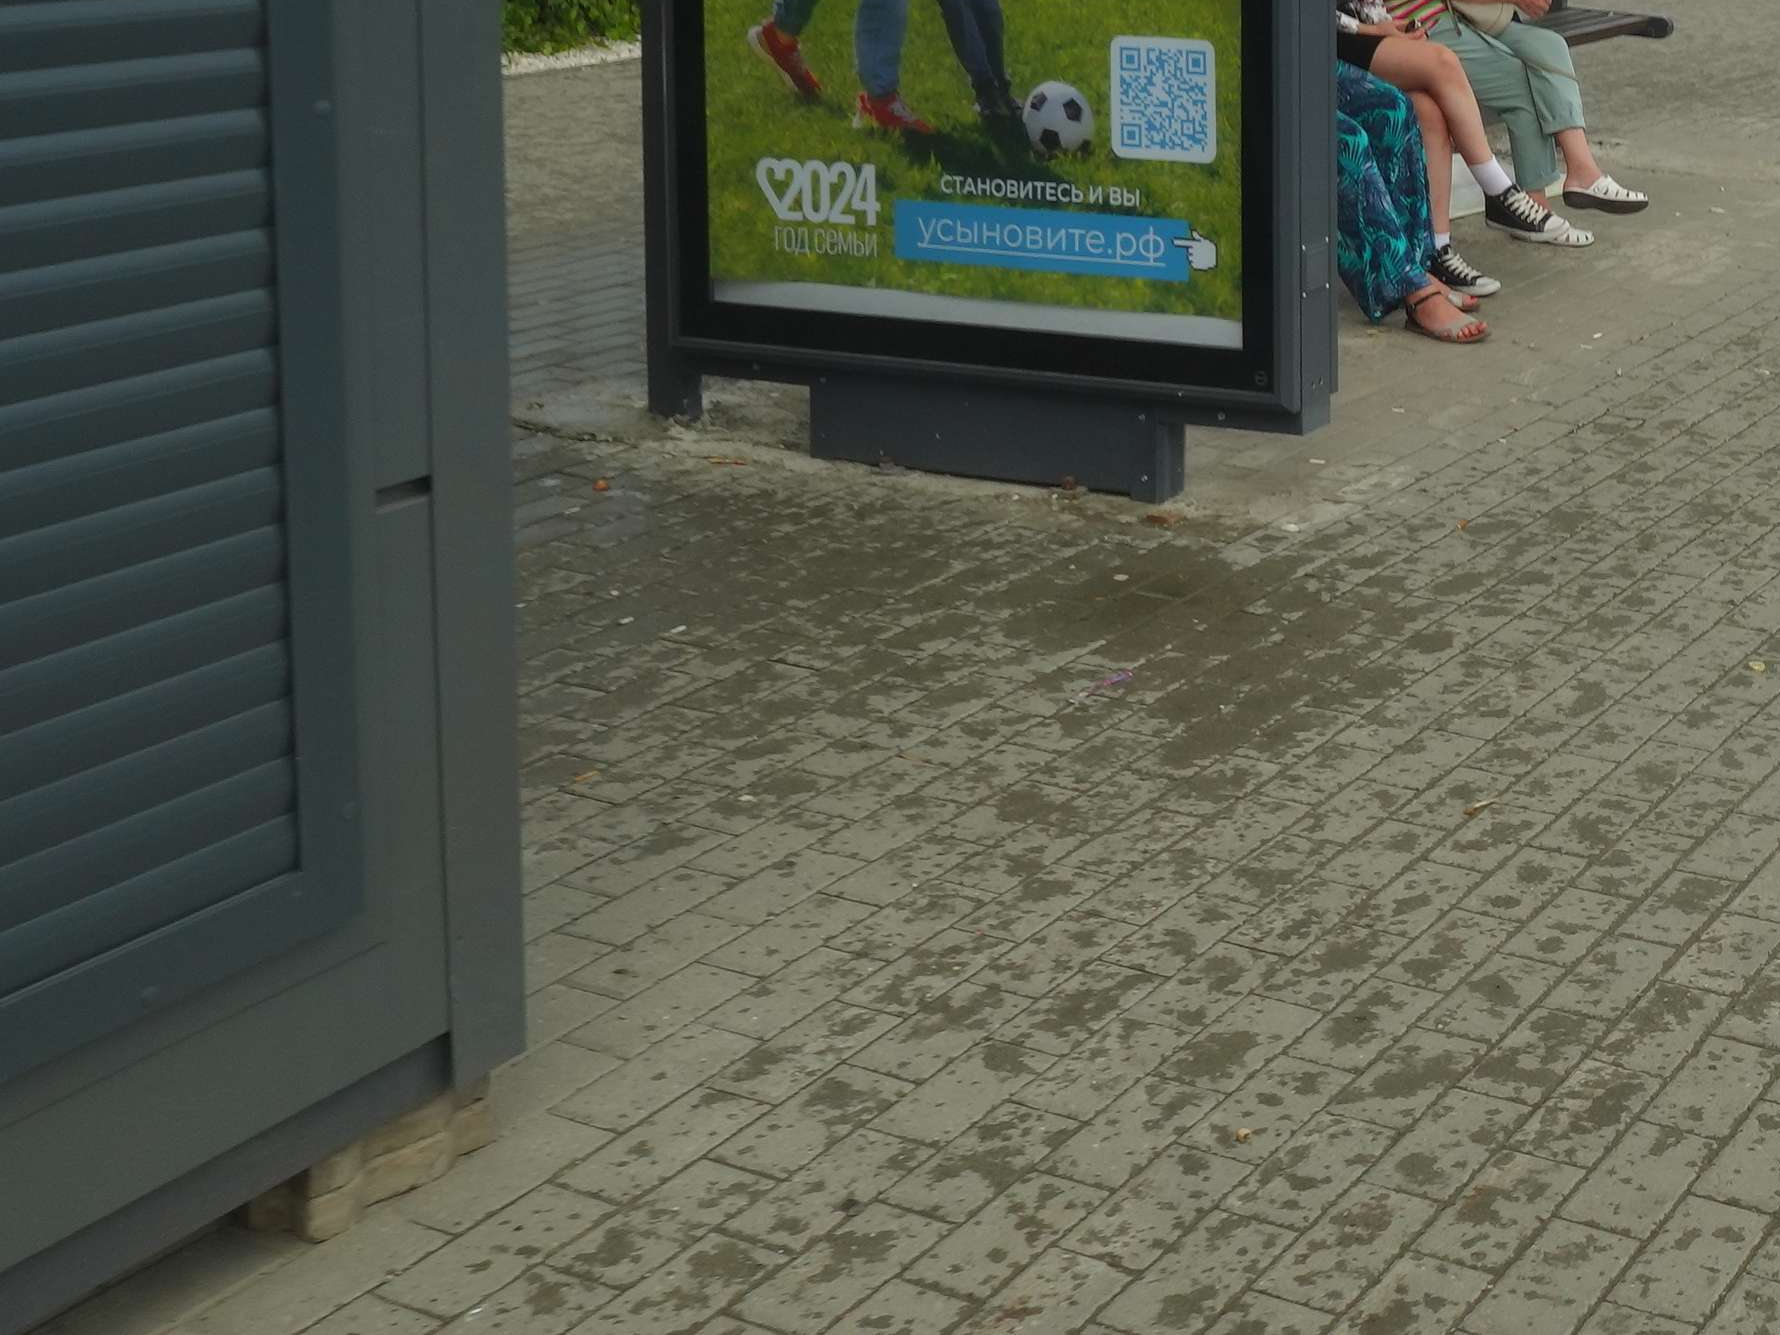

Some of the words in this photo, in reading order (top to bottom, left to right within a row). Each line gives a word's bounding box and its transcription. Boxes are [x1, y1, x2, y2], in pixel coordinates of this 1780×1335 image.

[772, 160, 880, 226] 2024
[940, 175, 1084, 204] СТАНОВИТЕСЬ
[1089, 186, 1104, 204] И
[1109, 187, 1141, 207] ВЫ
[917, 217, 1166, 263] усыновите.рф
